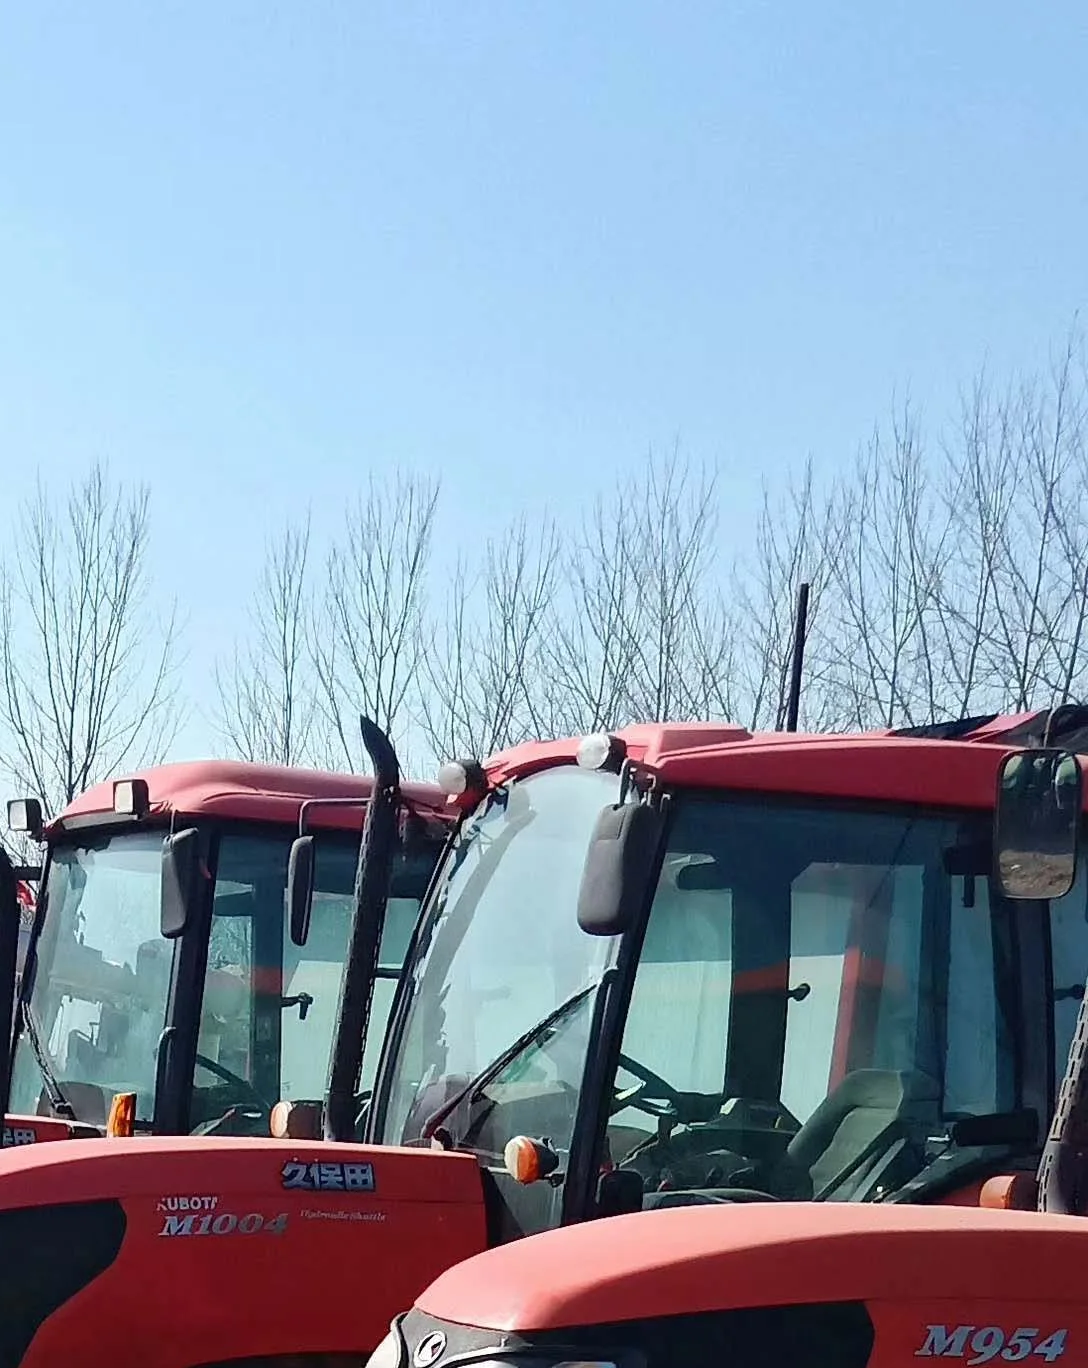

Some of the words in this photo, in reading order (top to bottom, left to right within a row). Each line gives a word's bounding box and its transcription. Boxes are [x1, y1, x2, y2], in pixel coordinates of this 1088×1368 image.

[282, 1163, 375, 1190] 久保田
[158, 1213, 289, 1236] M1004
[914, 1325, 1068, 1366] M954
